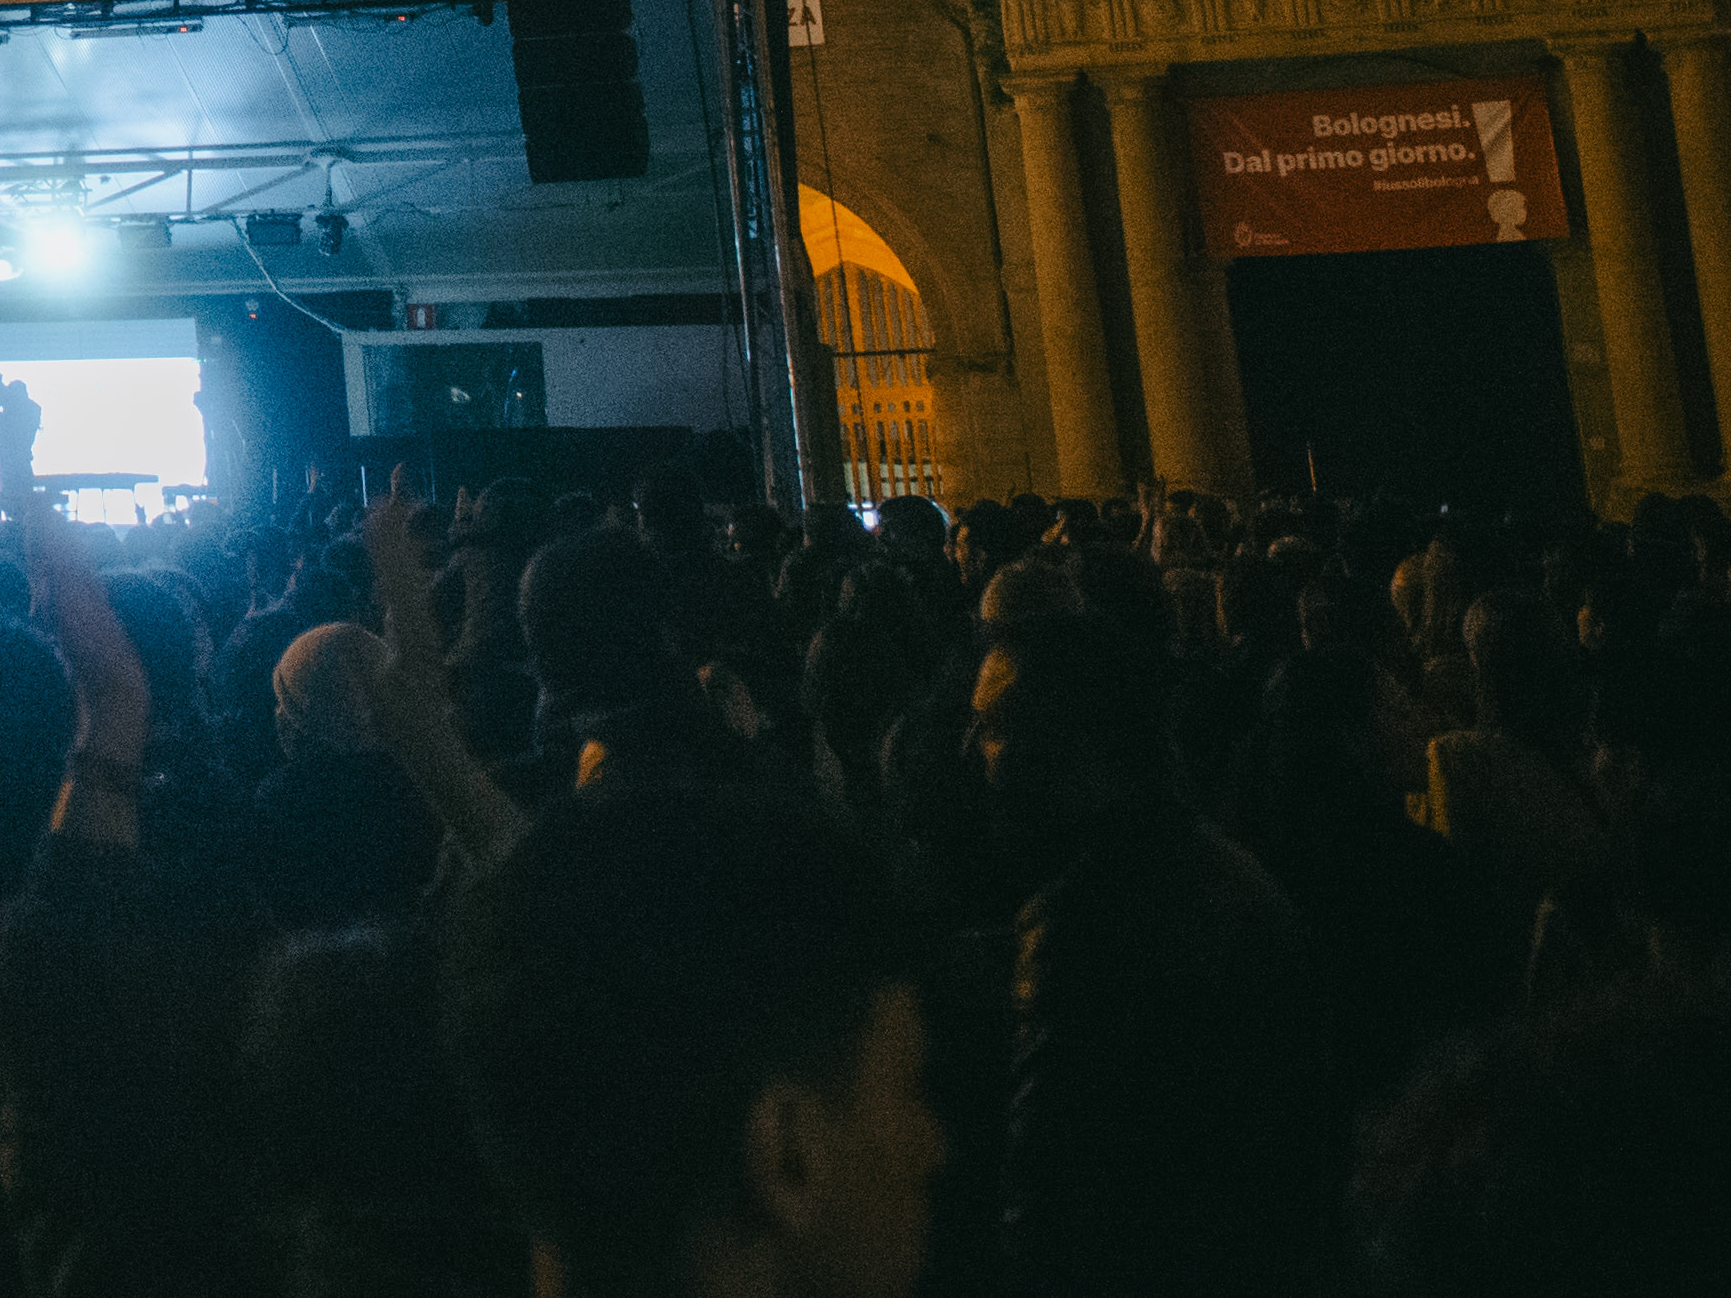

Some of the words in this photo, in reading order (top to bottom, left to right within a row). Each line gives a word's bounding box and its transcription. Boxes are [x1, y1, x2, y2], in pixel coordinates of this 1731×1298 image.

[1313, 104, 1471, 139] Bolognesi.
[1223, 148, 1272, 175] Dal
[1276, 145, 1364, 178] primo
[1369, 141, 1477, 172] giorno.
